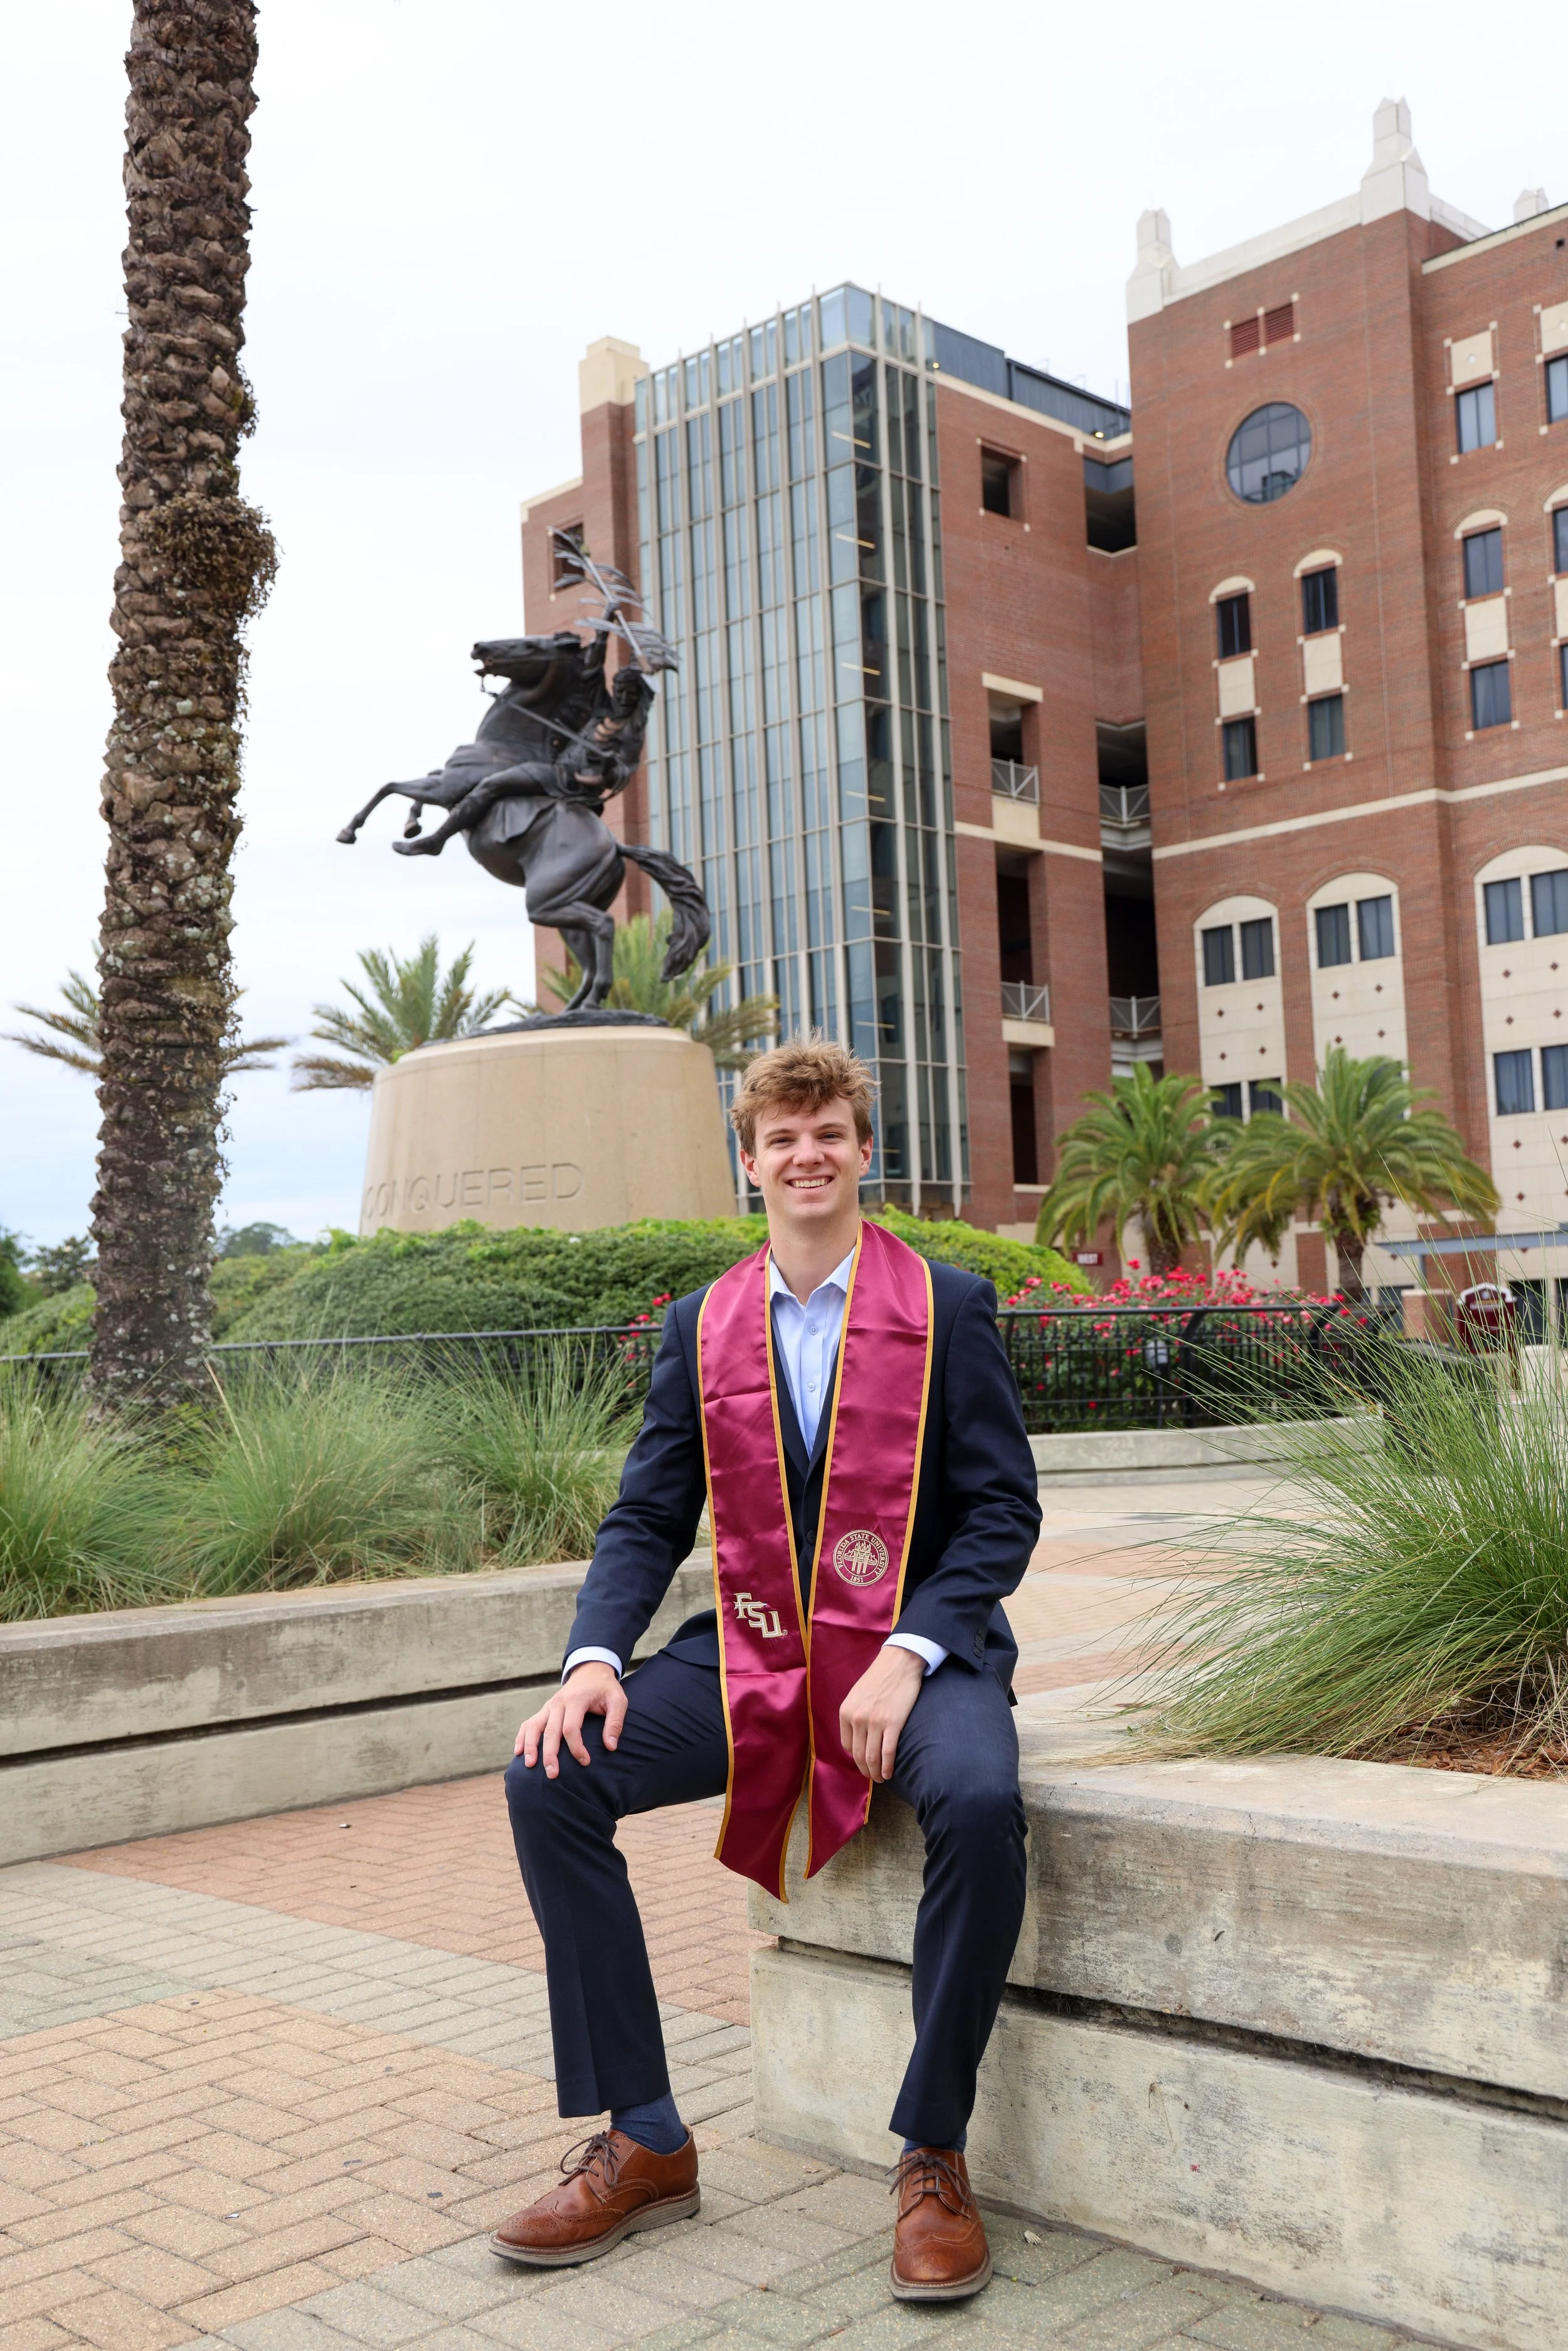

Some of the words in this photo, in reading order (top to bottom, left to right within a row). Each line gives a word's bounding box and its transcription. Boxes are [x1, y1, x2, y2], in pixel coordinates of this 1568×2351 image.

[364, 1162, 583, 1219] CONQUERED
[837, 1539, 850, 1569] FLORIDA
[849, 1533, 870, 1541] STATE
[871, 1537, 886, 1576] UNIVERSITY
[733, 1592, 784, 1638] FSU
